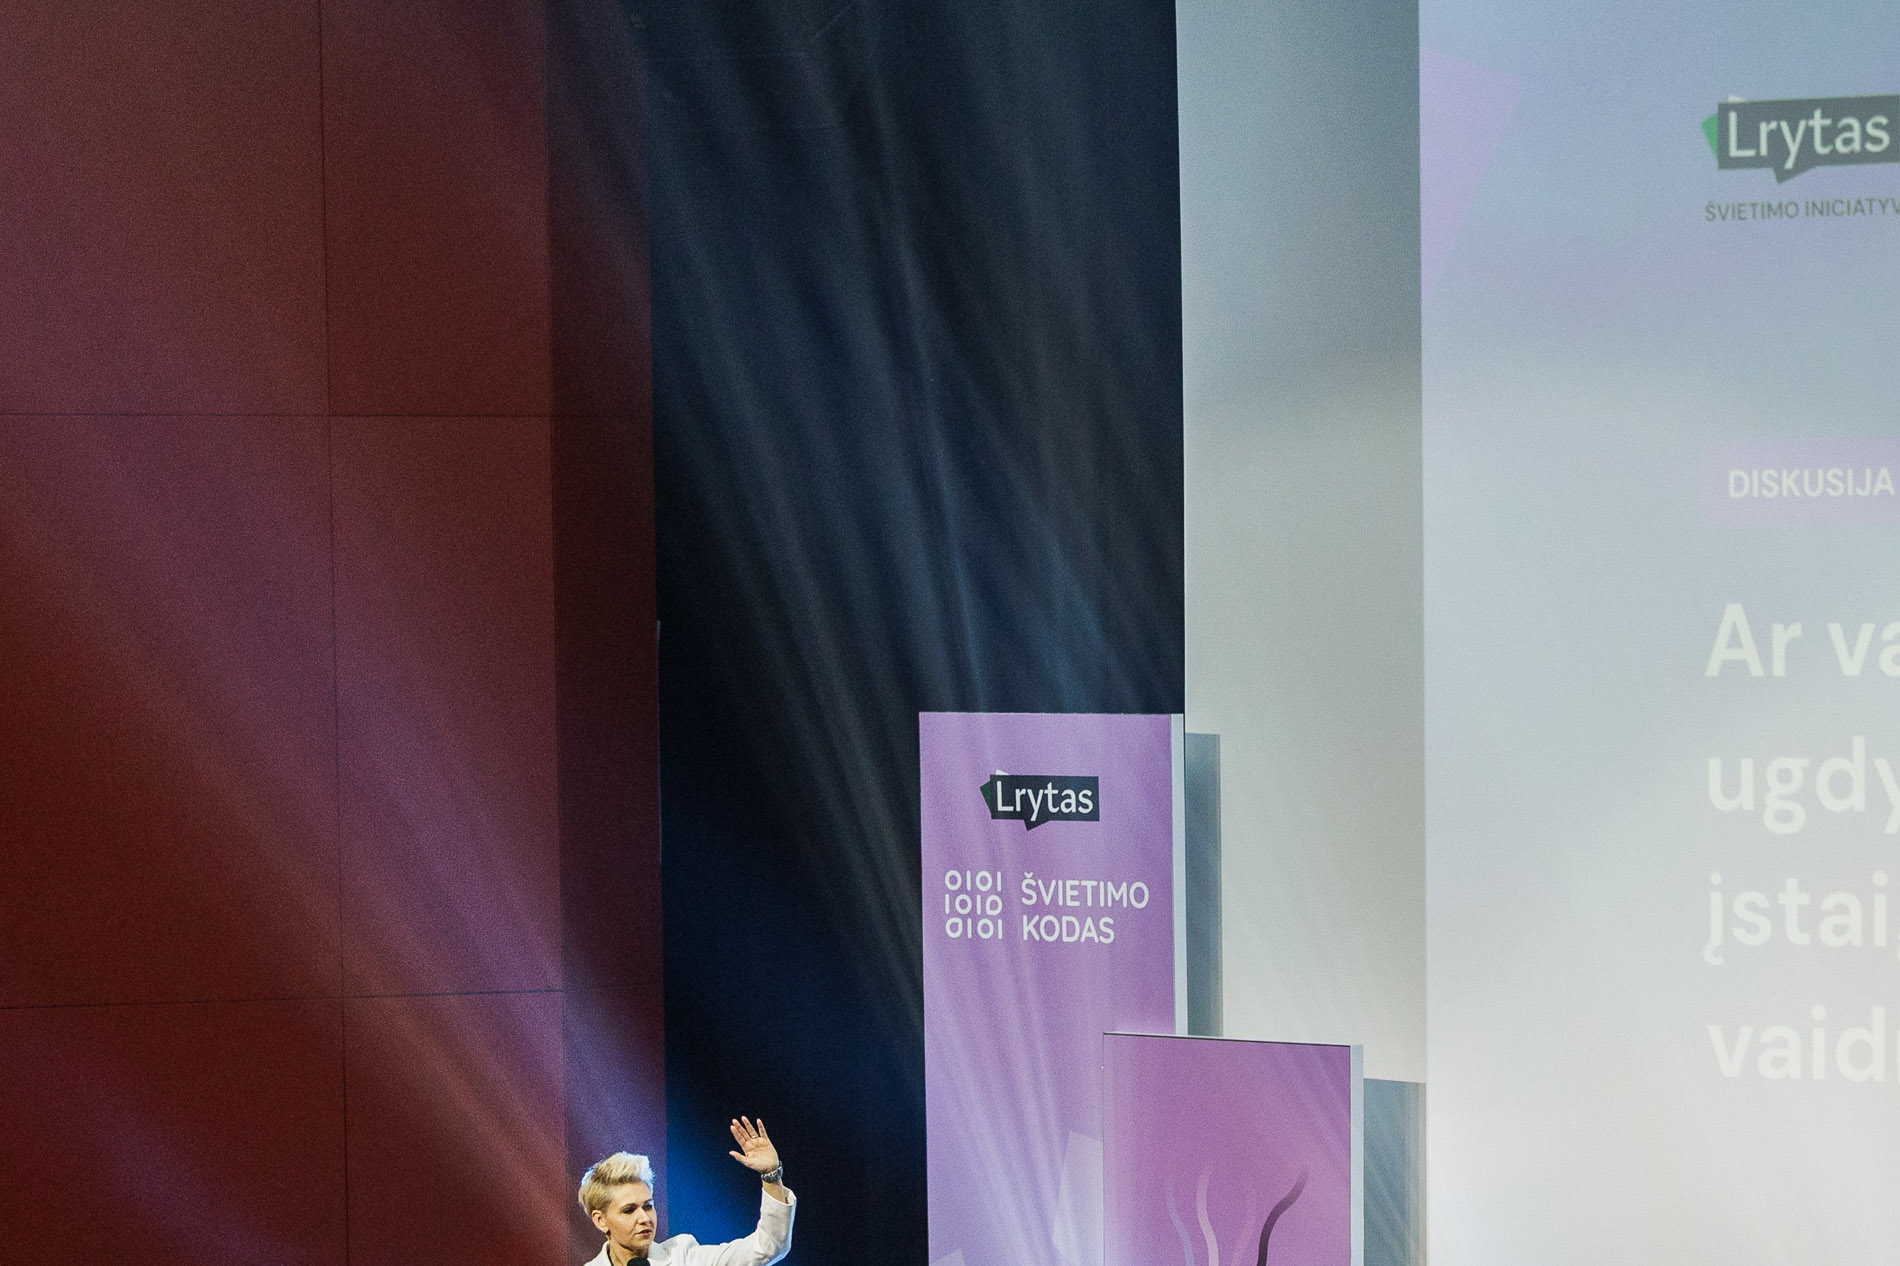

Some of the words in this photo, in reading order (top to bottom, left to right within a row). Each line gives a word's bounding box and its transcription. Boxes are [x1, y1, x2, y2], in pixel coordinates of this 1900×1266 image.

[1728, 108, 1891, 170] Lrytas
[1704, 200, 1800, 222] ŠVIETIMO
[1728, 467, 1896, 500] DISKUSIJA
[1704, 602, 1803, 679] Ar
[996, 780, 1094, 822] Lrytas
[1020, 871, 1149, 909] ŠVIETIMO
[1022, 915, 1115, 944] KODAS
